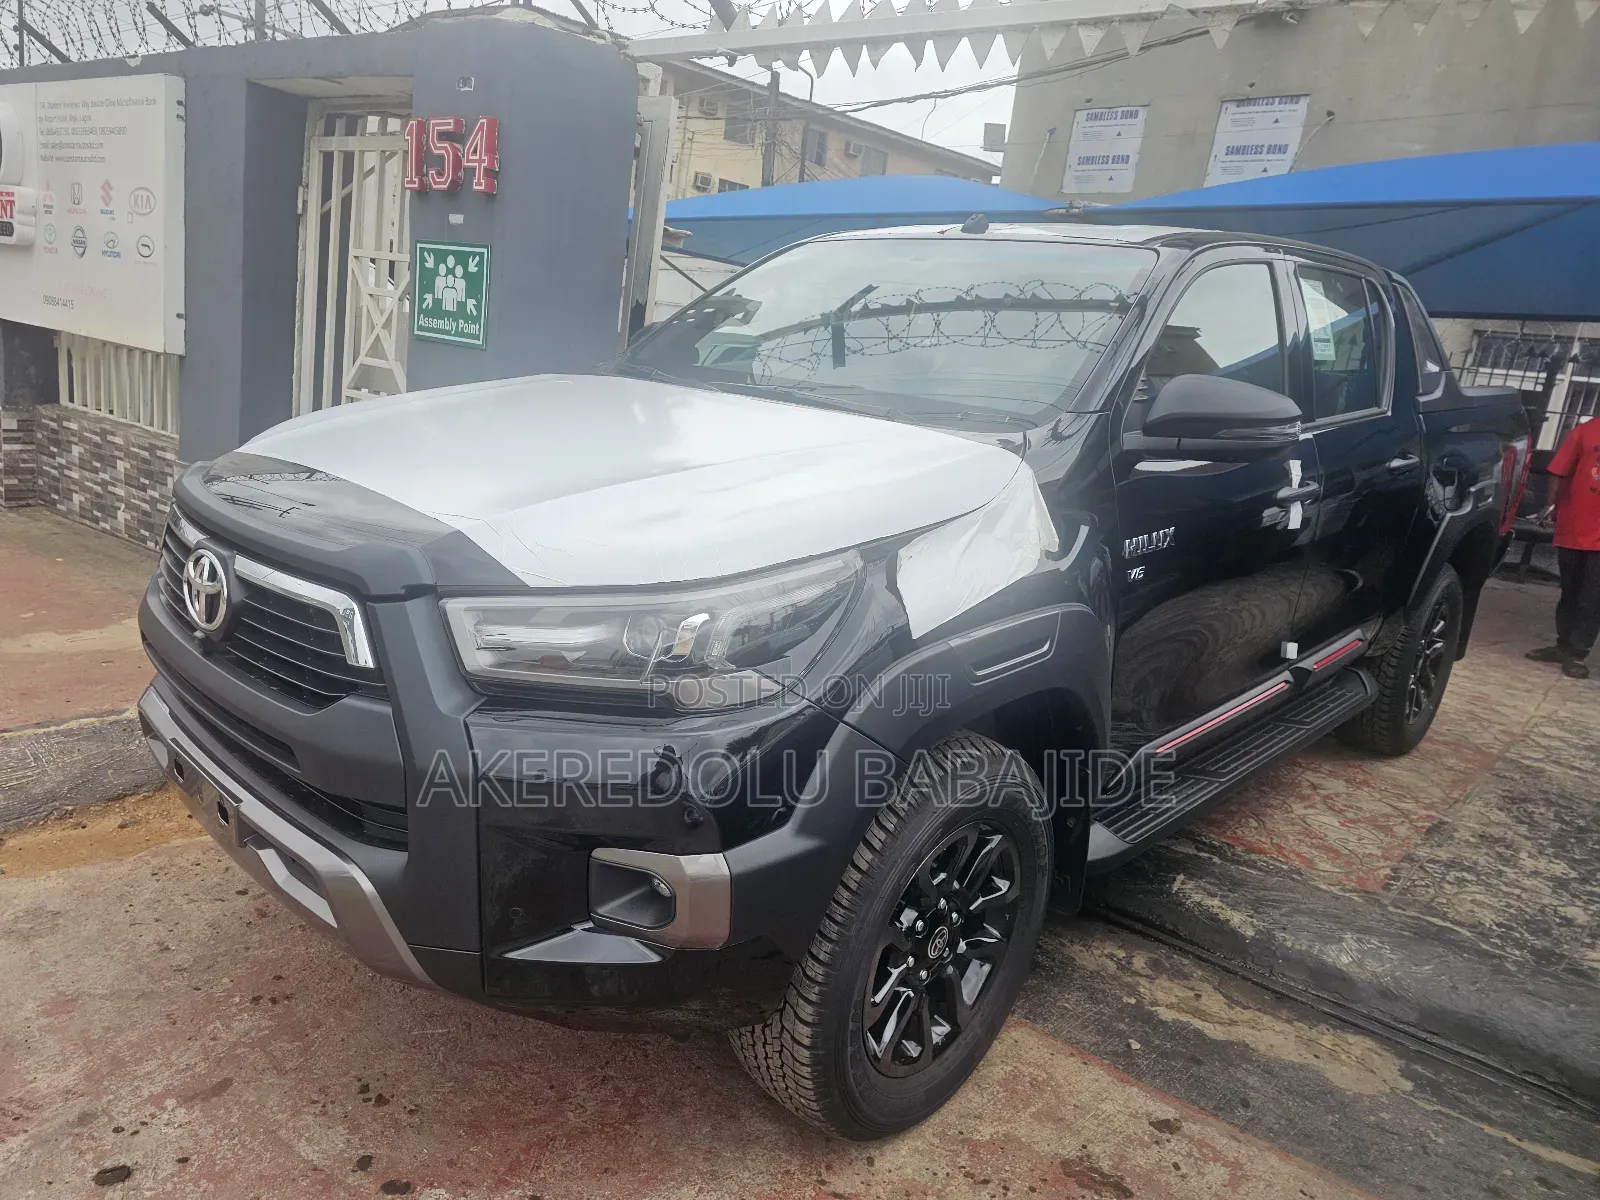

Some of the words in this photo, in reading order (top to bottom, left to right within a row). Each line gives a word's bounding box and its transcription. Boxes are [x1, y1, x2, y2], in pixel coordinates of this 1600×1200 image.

[146, 96, 157, 106] Bank
[1085, 110, 1119, 122] SAMBLESS
[1120, 110, 1140, 120] BOND
[404, 115, 499, 194] 154
[1224, 144, 1266, 156] SAMBLESS
[1266, 144, 1290, 155] BOND
[1077, 154, 1110, 166] SAMBLESS
[1110, 154, 1131, 165] BOND
[134, 194, 153, 209] KIA
[418, 313, 457, 335] Assembly
[458, 319, 480, 335] Point
[1122, 526, 1176, 559] HILUX
